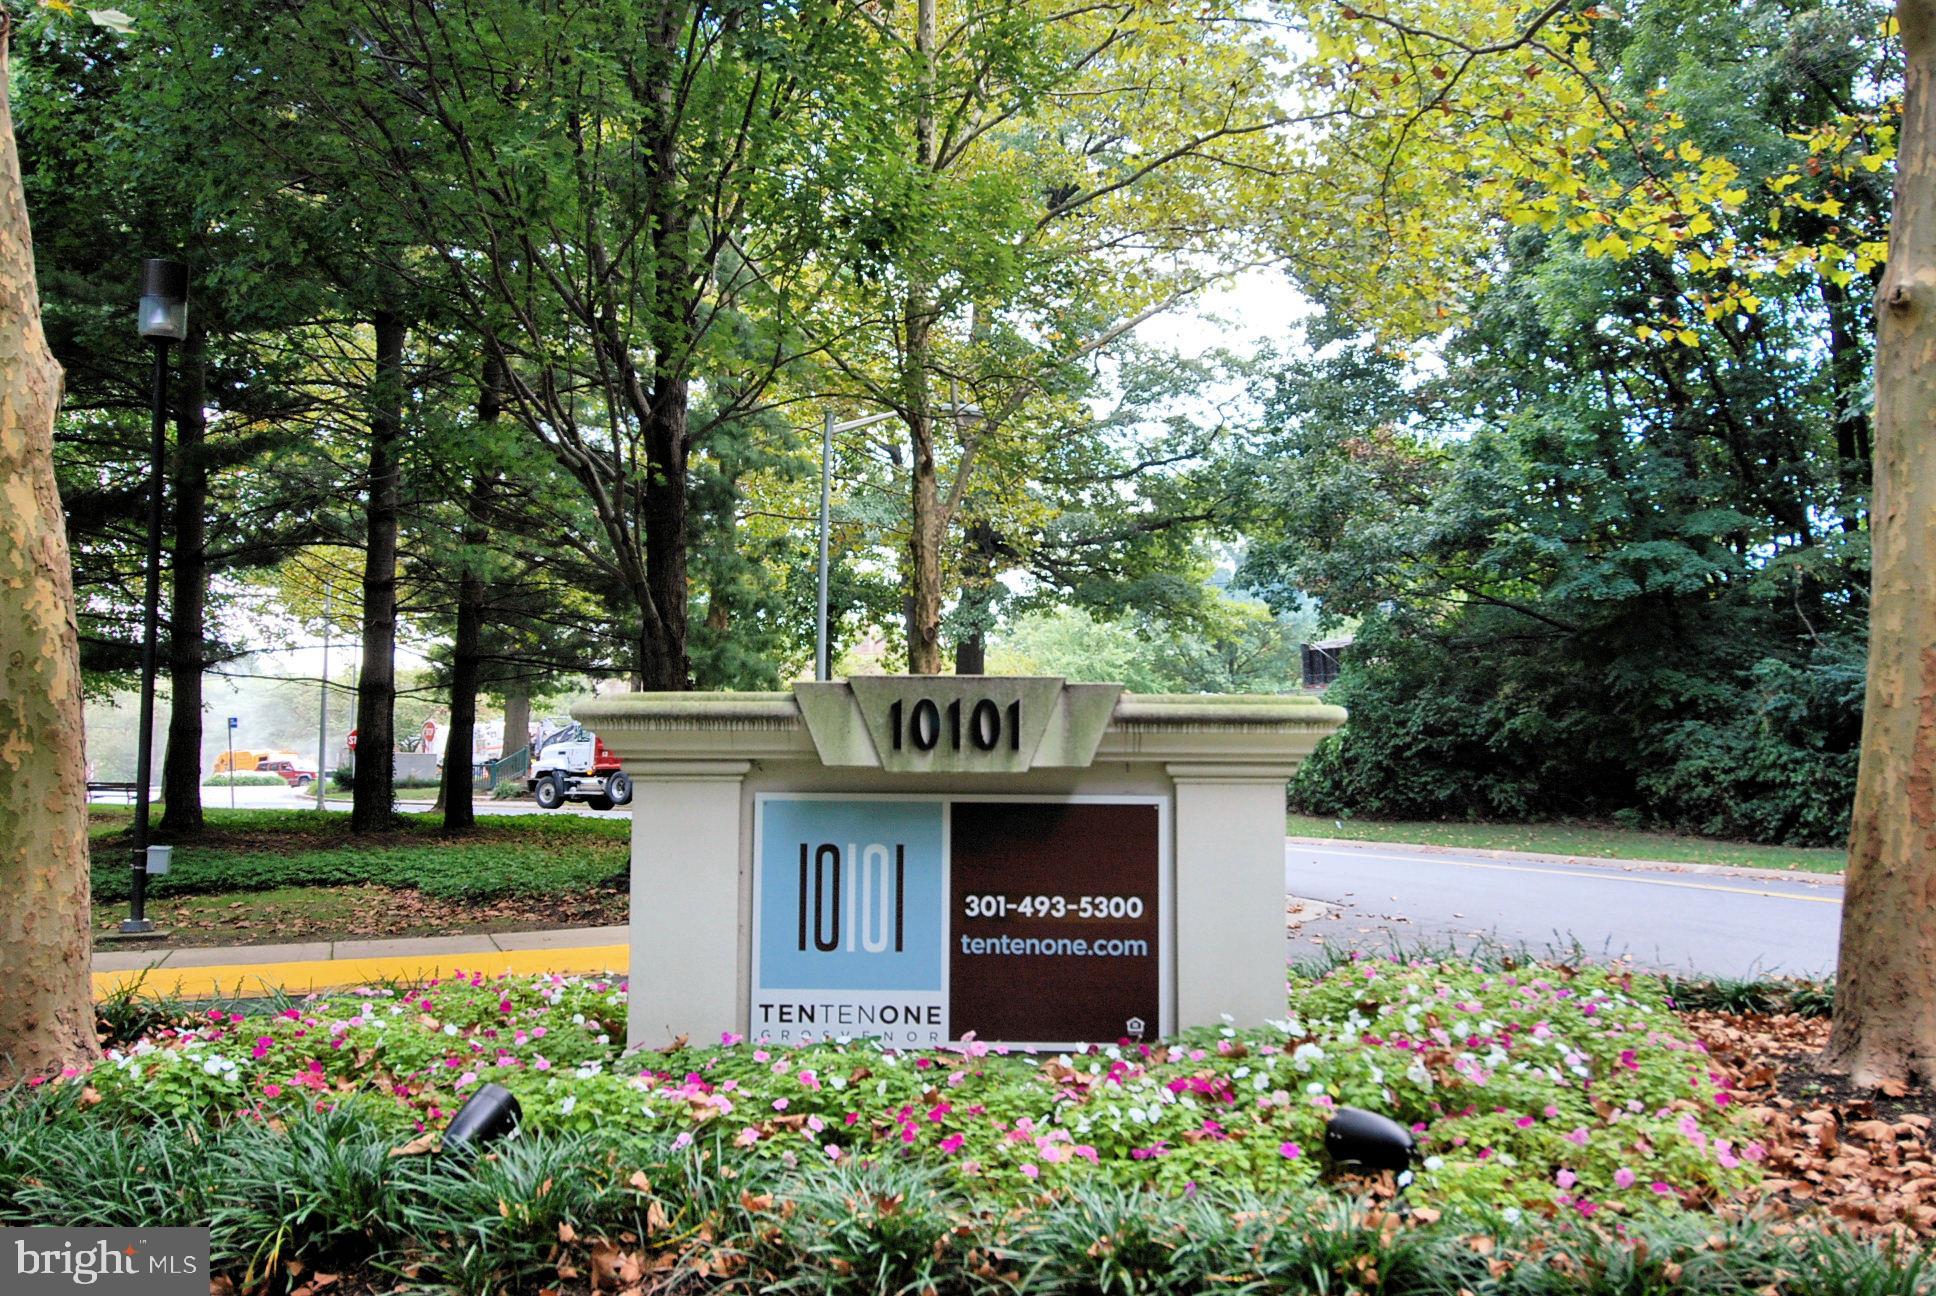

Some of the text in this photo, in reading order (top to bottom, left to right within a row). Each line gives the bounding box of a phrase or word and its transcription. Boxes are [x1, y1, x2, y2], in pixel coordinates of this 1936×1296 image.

[890, 699, 1020, 751] 10101
[965, 895, 1144, 918] 301-493-5300
[961, 934, 1148, 957] tentenone.com
[759, 1004, 942, 1025] TENTENONE
